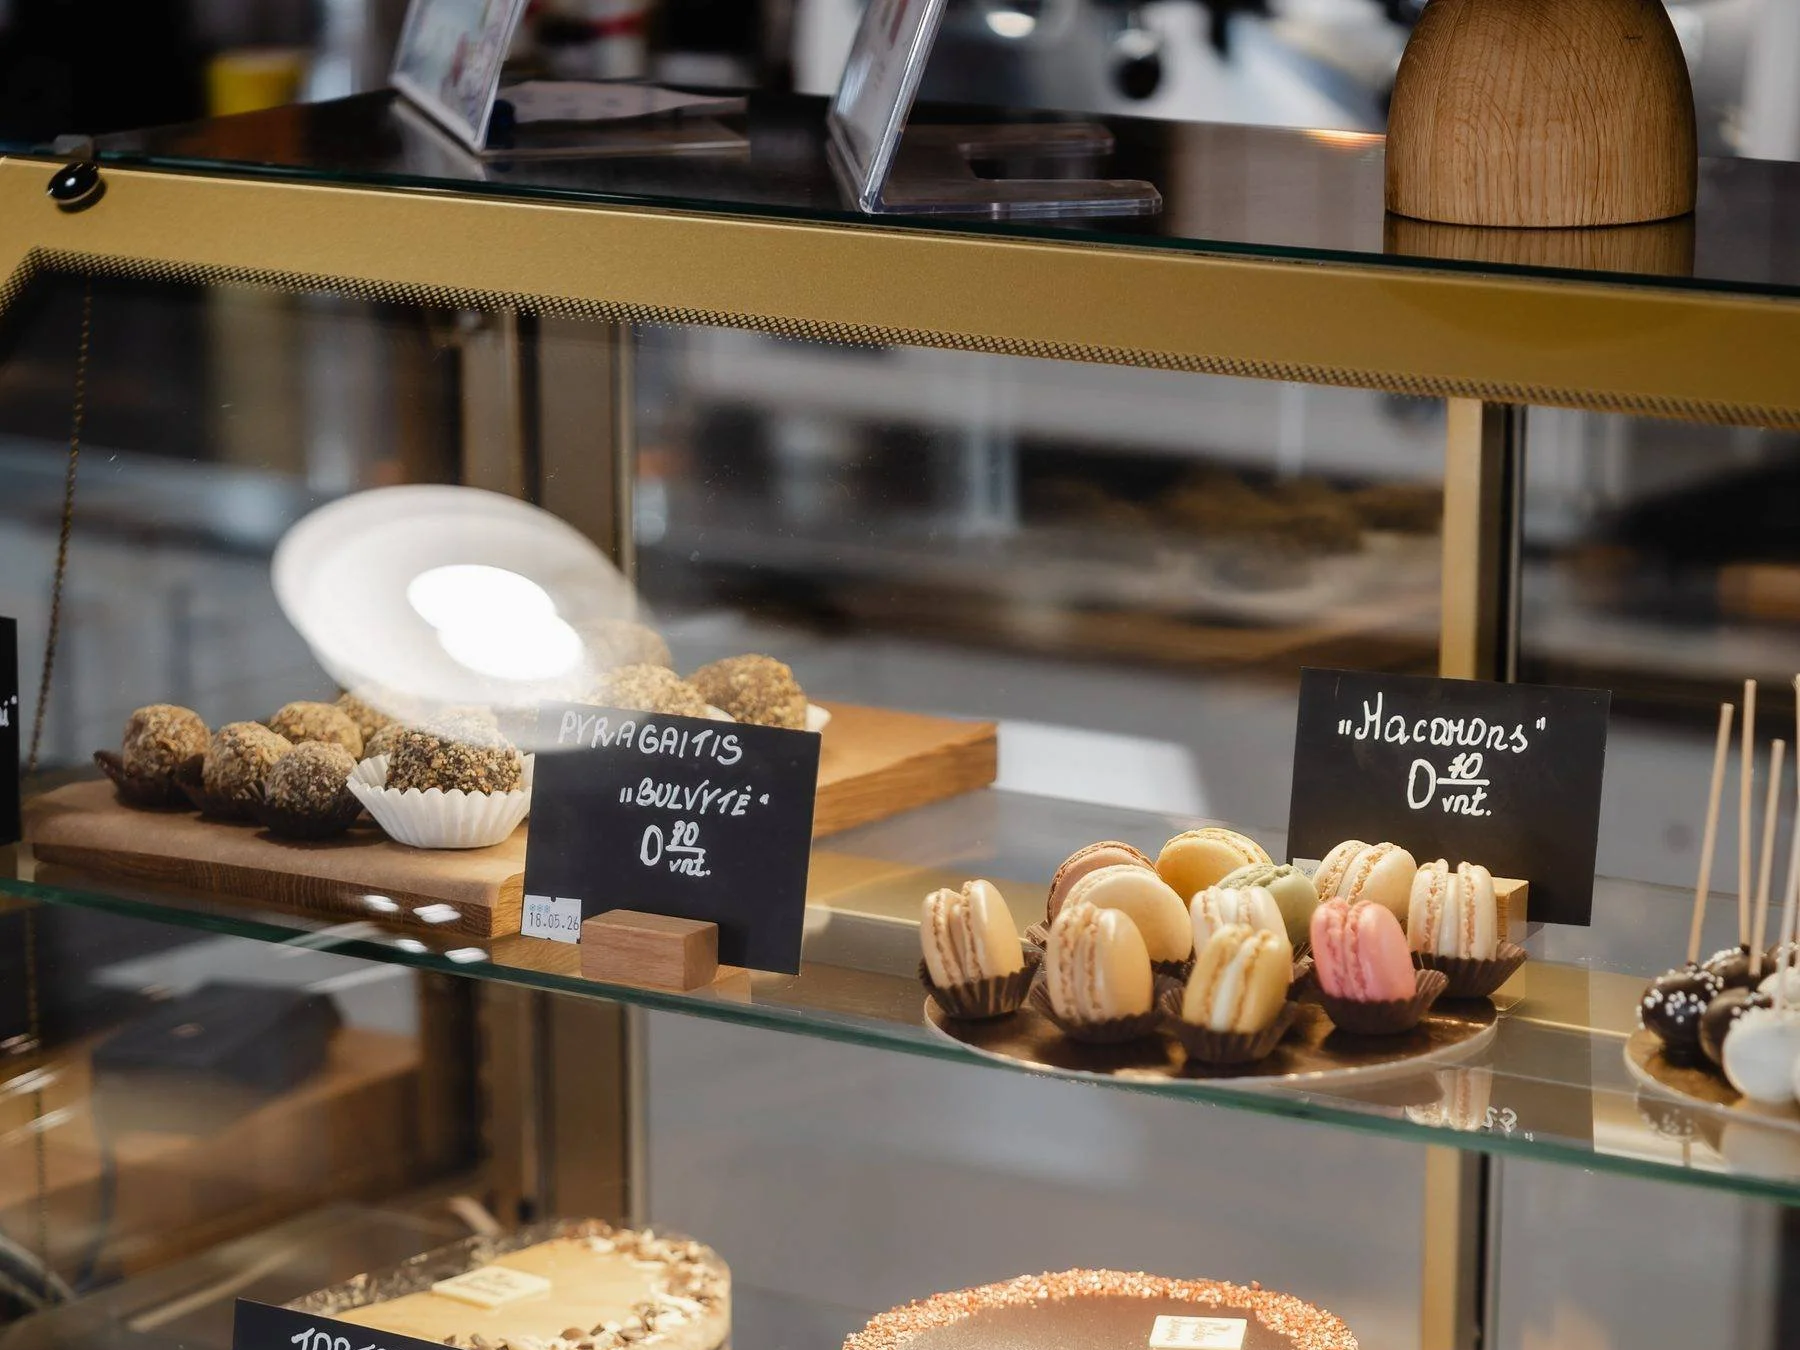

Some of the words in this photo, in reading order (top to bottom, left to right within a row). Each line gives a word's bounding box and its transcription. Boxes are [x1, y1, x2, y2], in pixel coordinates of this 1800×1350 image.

[557, 710, 743, 766] PYRAGAITIS
[1442, 786, 1492, 816] vnt.
[669, 852, 712, 877] vnt.
[530, 912, 580, 931] 18.05.26
